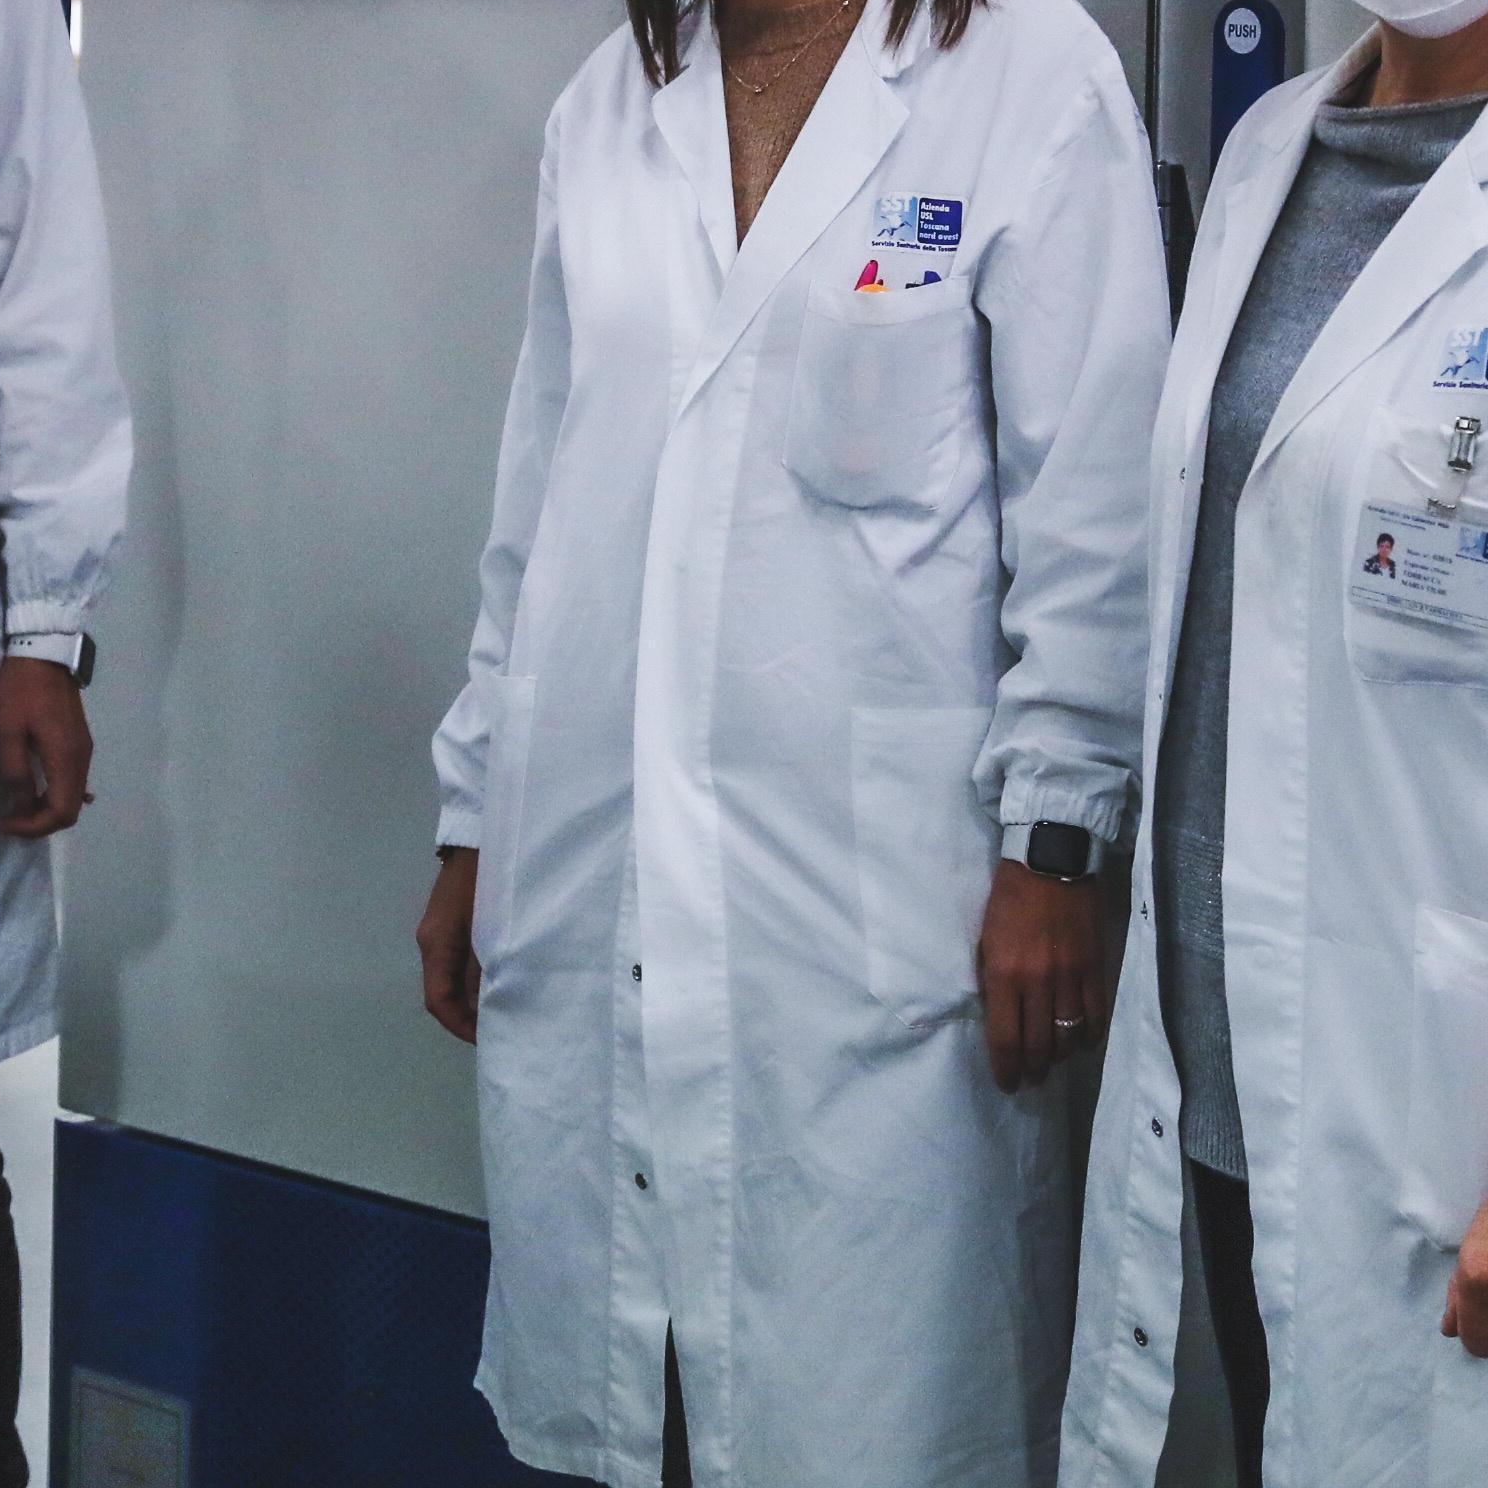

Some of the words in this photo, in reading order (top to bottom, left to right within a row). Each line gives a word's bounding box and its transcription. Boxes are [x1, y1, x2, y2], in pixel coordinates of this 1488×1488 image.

[1228, 23, 1257, 39] PUSH
[920, 202, 950, 212] Azienda
[920, 212, 933, 220] USL
[920, 221, 949, 231] Toscana
[919, 232, 936, 240] nord
[938, 233, 959, 241] ovest
